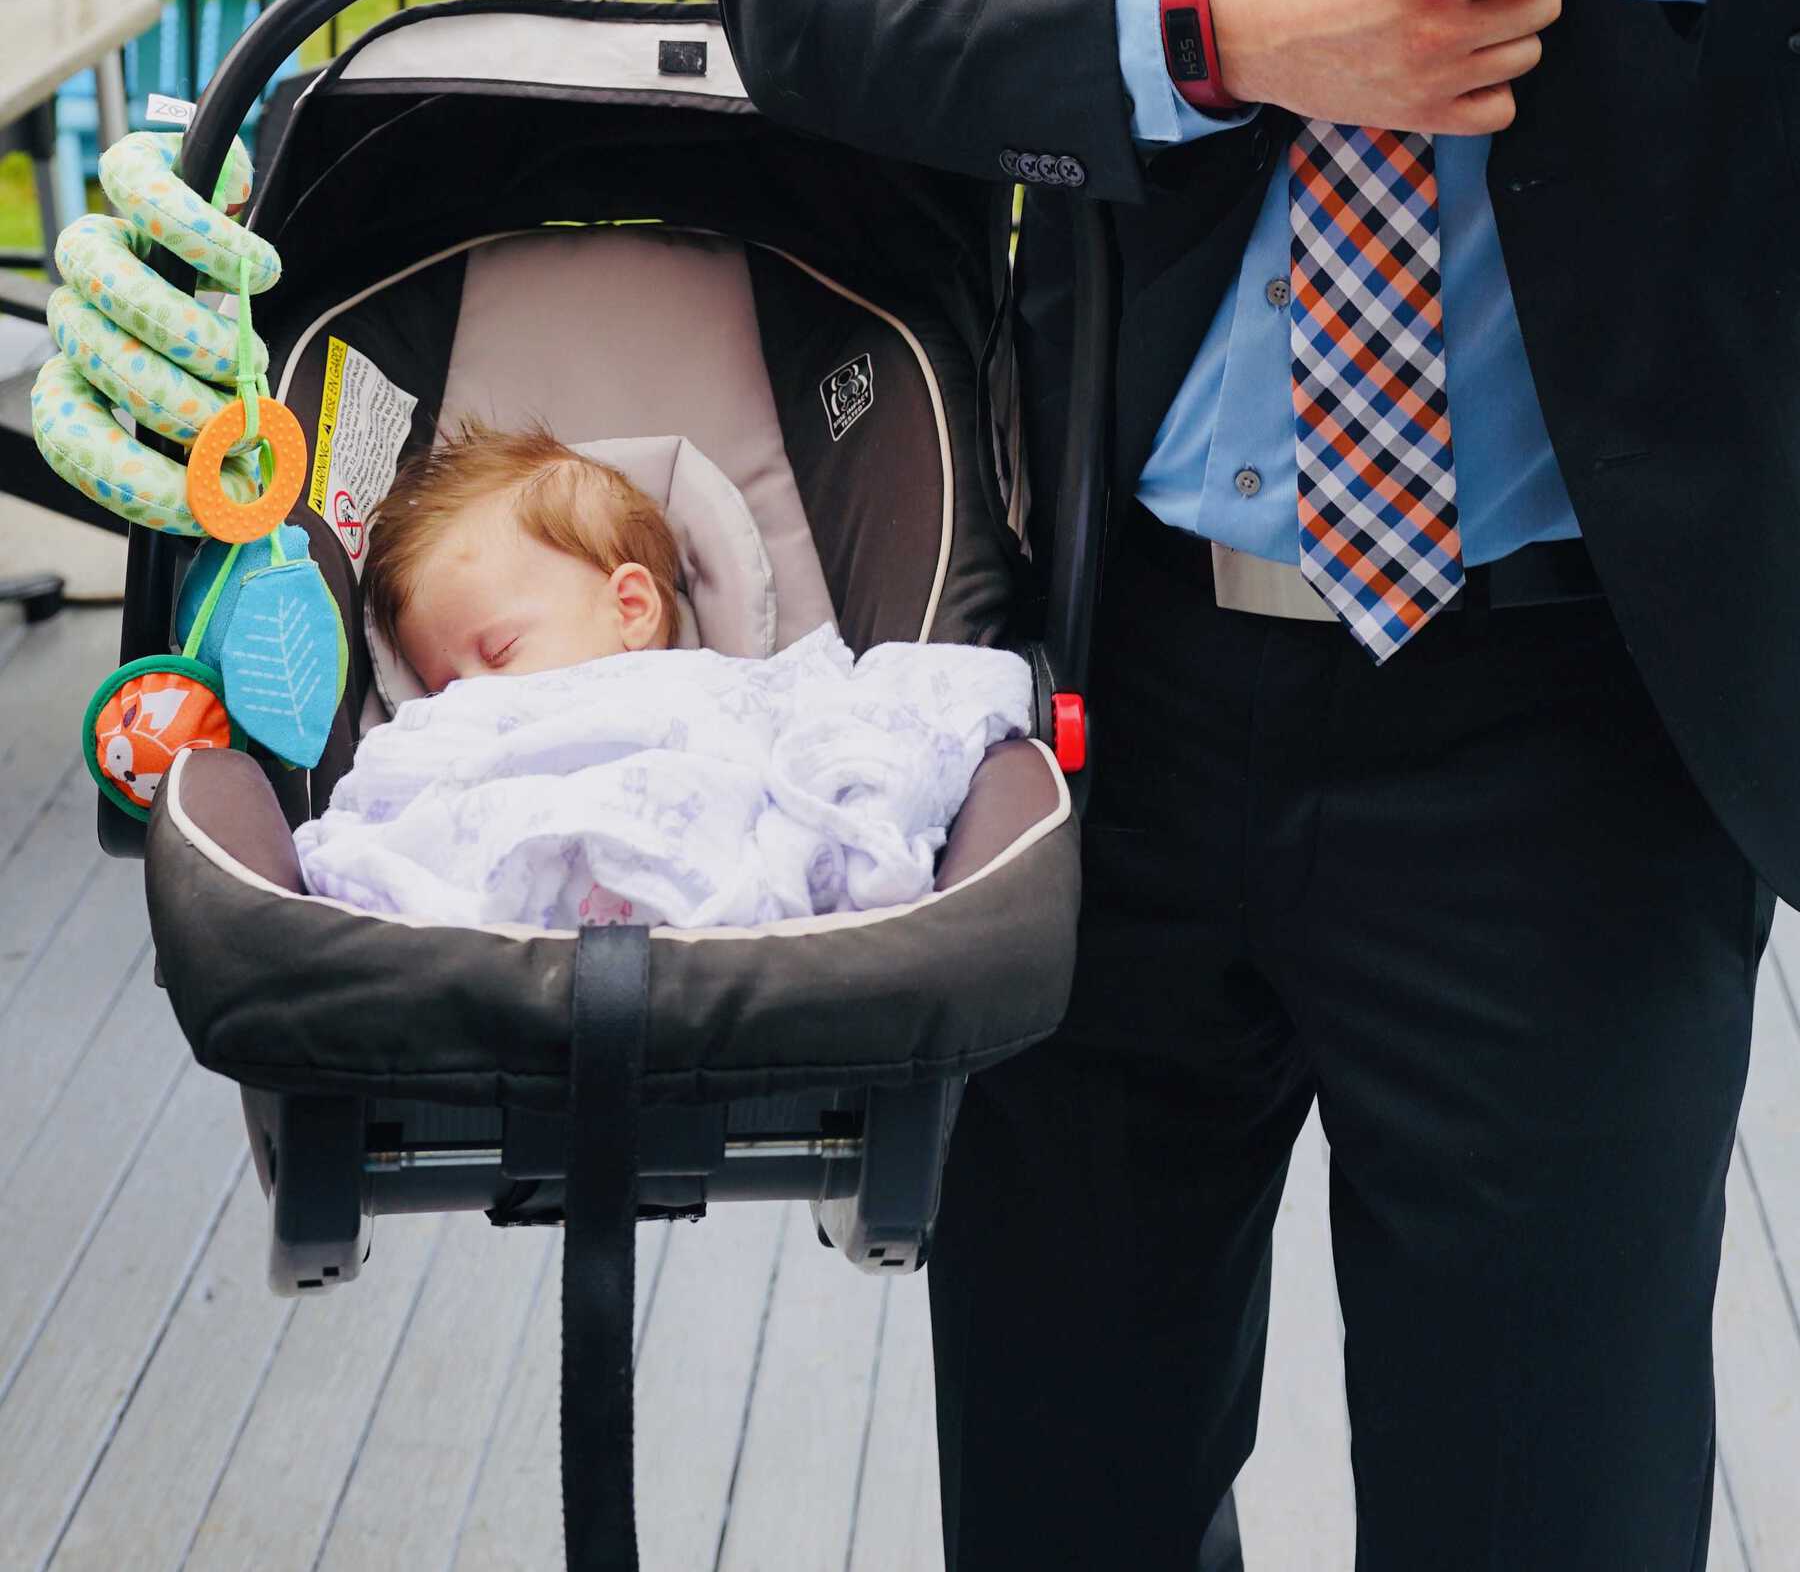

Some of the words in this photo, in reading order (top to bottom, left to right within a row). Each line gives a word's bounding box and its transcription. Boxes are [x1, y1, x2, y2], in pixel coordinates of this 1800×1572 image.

[329, 342, 343, 378] GARDE
[327, 375, 339, 393] EN
[323, 393, 336, 422] MISE
[311, 439, 329, 499] WARNING
